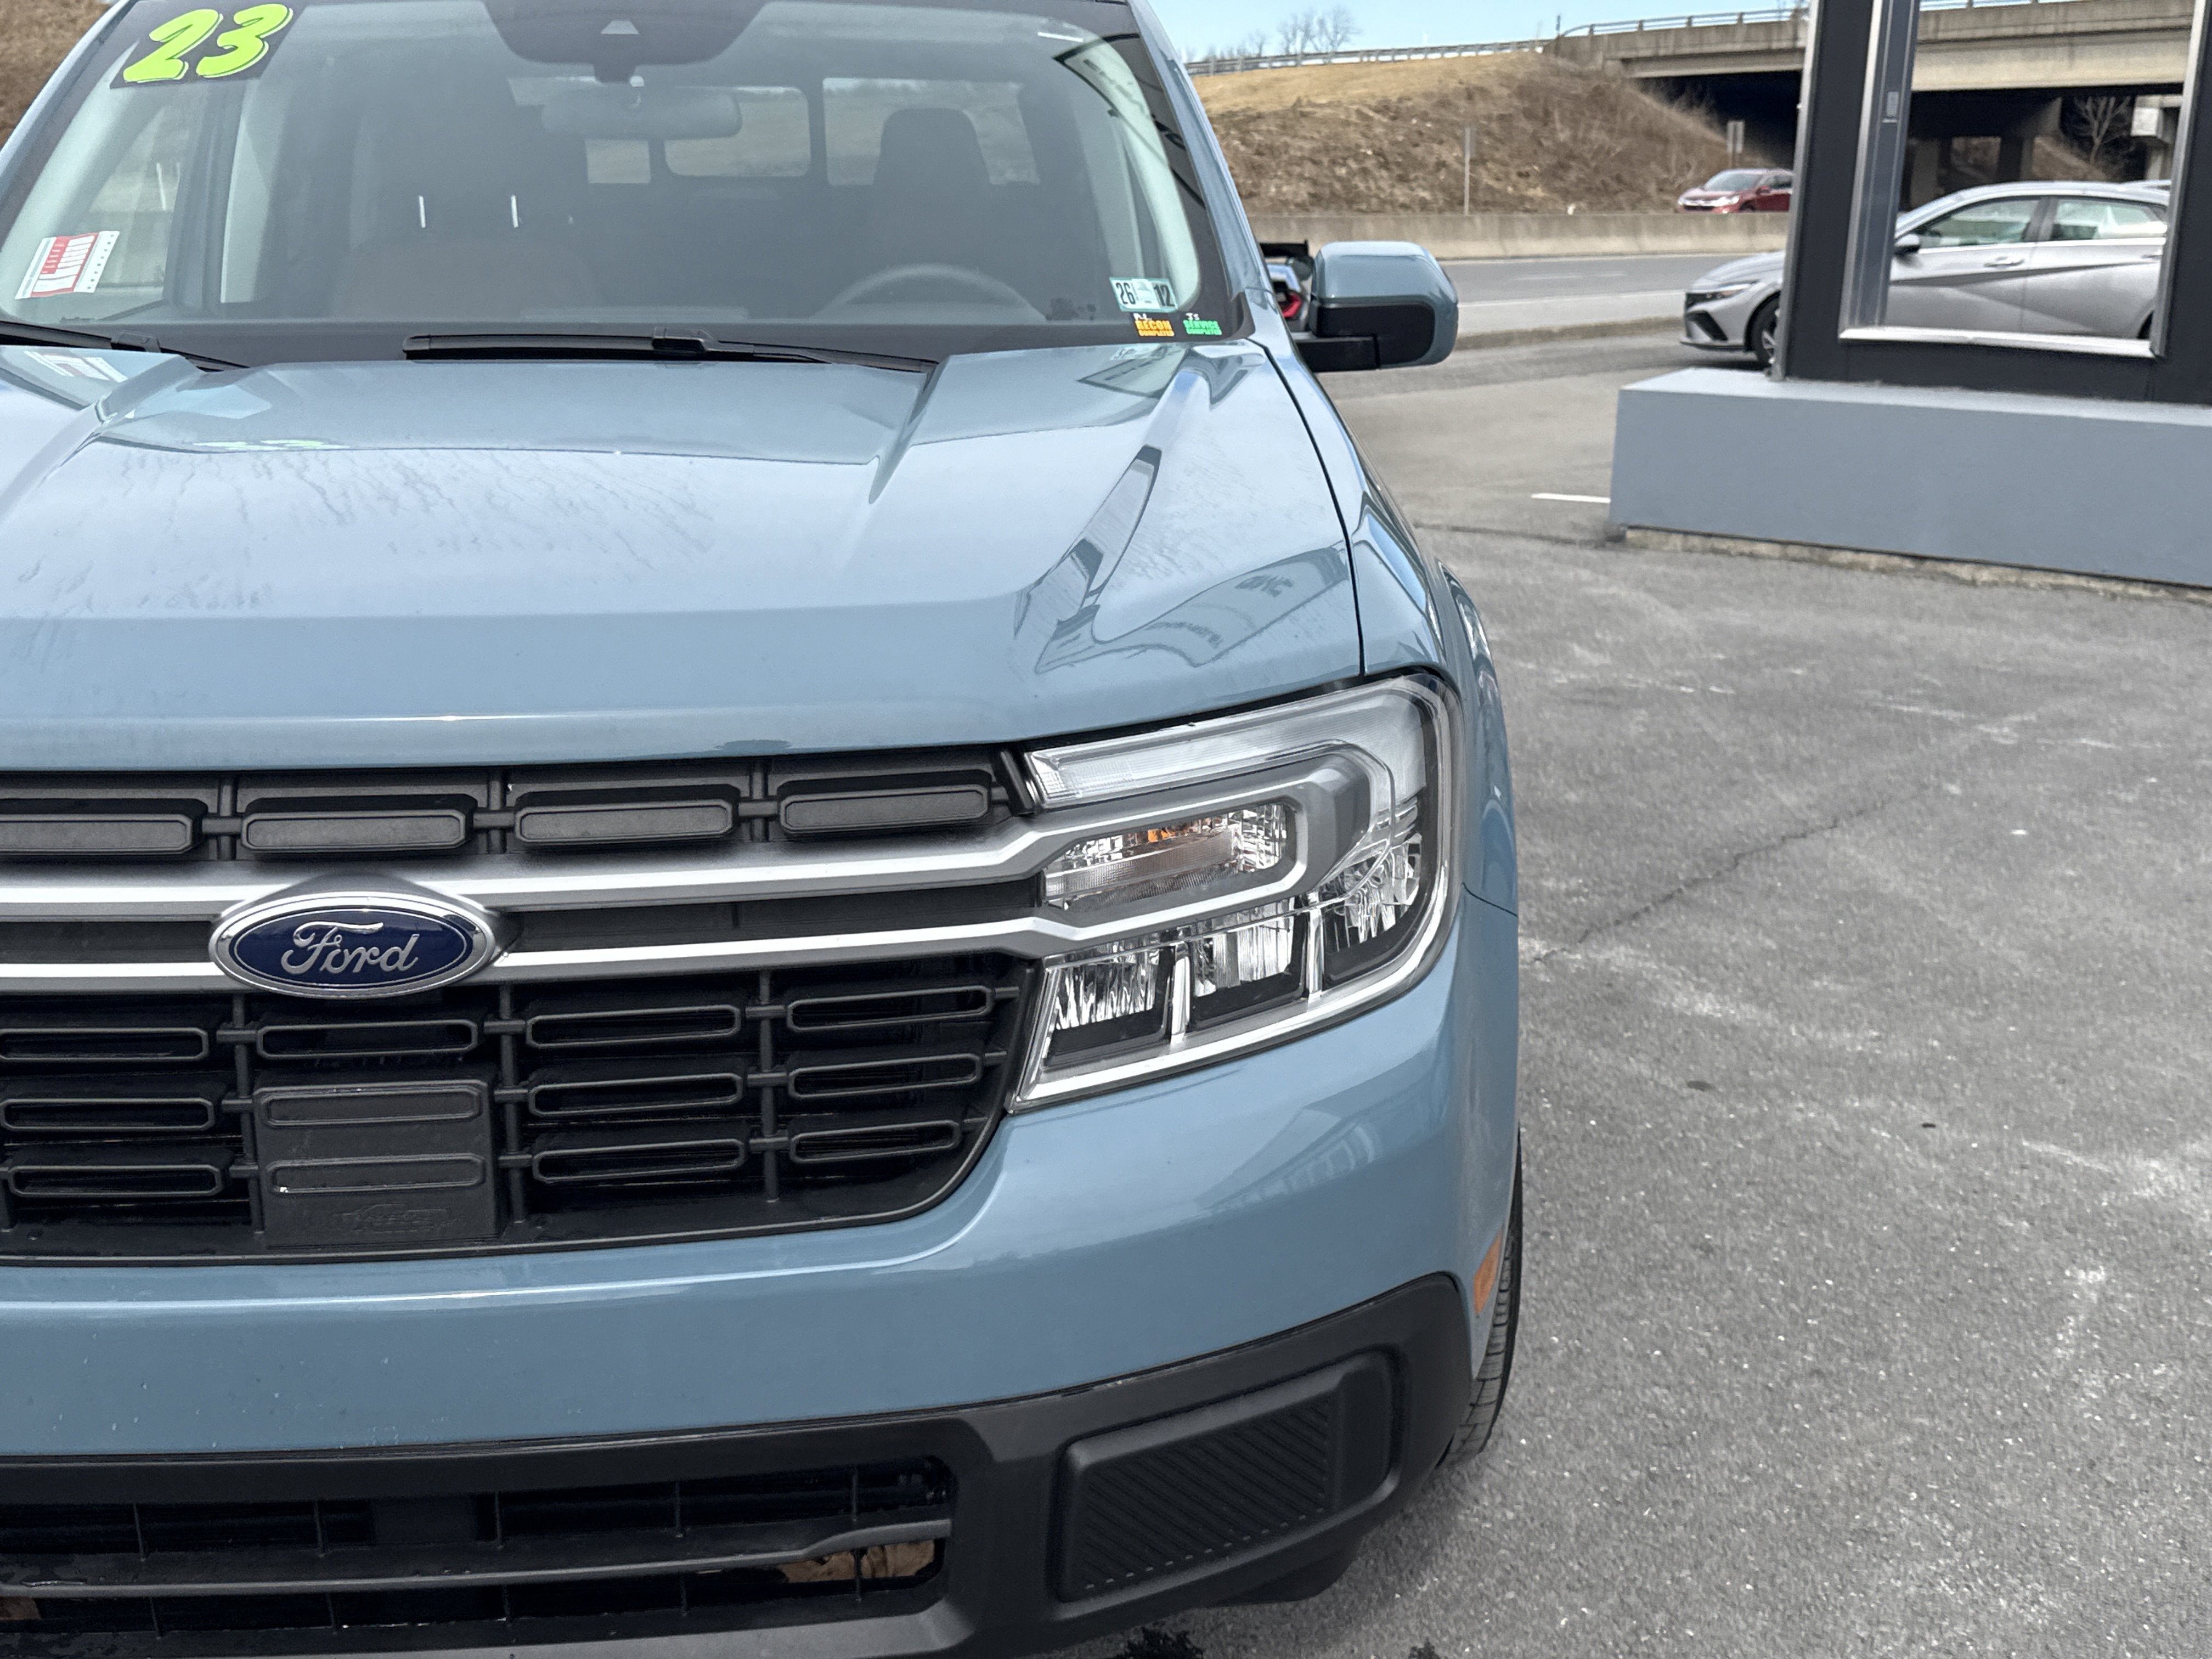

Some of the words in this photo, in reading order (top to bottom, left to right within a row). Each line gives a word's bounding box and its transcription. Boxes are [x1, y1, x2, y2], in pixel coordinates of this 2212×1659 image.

[123, 3, 294, 83] 23
[1115, 282, 1136, 304] 26
[1154, 284, 1175, 307] 12
[1135, 320, 1172, 330] RECON
[281, 921, 420, 974] Ford
